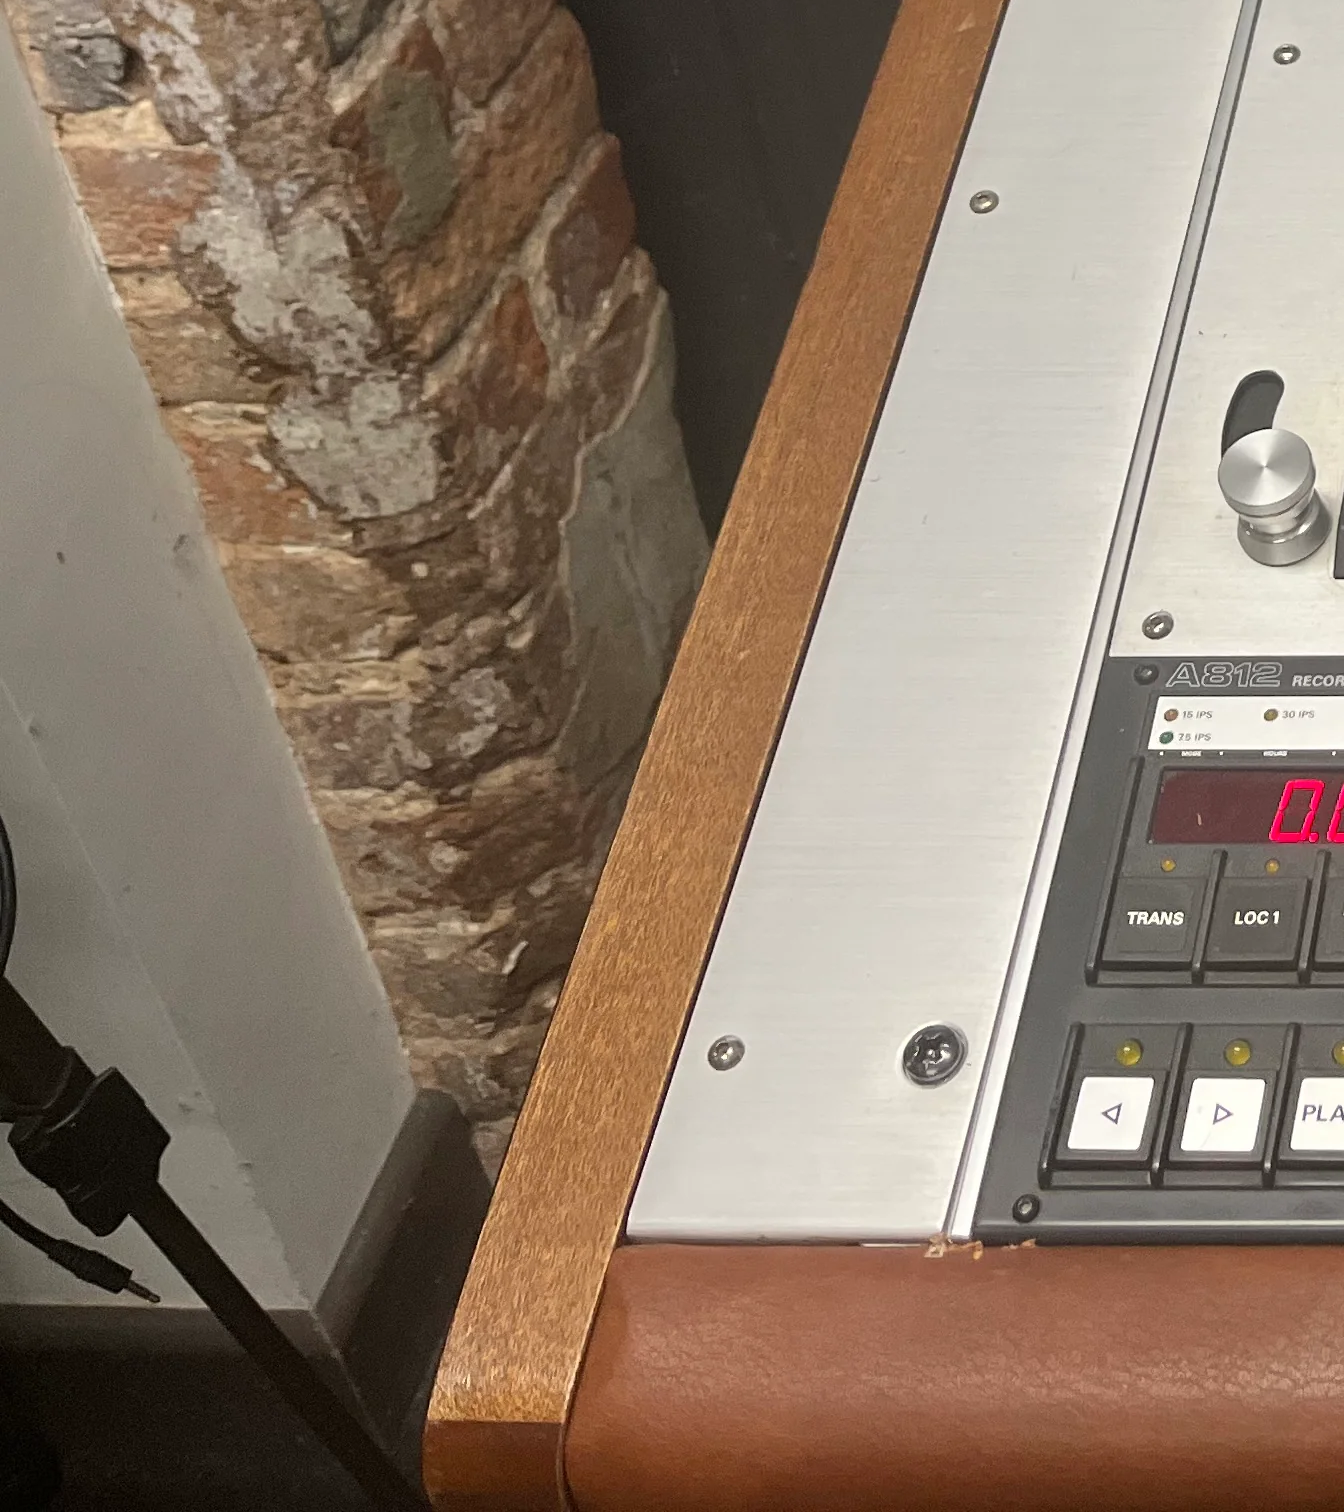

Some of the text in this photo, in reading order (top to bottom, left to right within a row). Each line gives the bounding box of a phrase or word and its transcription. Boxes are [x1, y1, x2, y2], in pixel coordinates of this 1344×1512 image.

[1166, 662, 1283, 687] A812
[1182, 710, 1213, 719] 15 IPS
[1282, 710, 1315, 719] 30 IPS
[1194, 733, 1212, 742] IPS
[1127, 911, 1185, 926] TRANS
[1234, 910, 1281, 925] LOC 1
